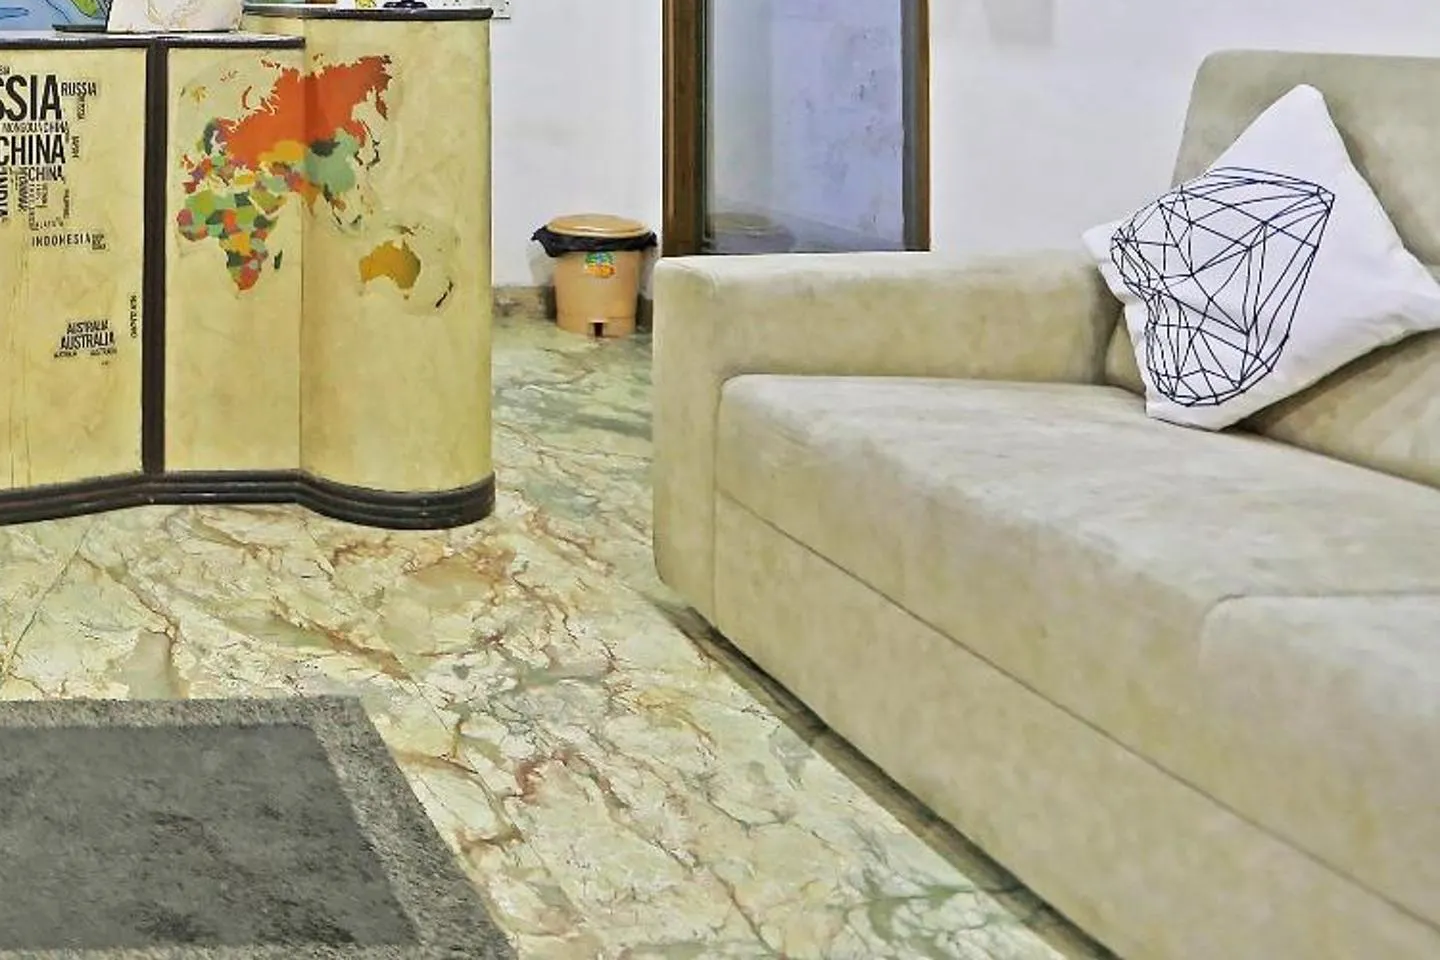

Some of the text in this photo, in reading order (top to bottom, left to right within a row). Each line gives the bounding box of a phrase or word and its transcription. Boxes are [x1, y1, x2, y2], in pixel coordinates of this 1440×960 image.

[61, 82, 97, 96] RUSSIA
[28, 166, 63, 181] CHINA
[32, 232, 91, 247] INDONESIA
[61, 331, 114, 349] AUSTRALIA
